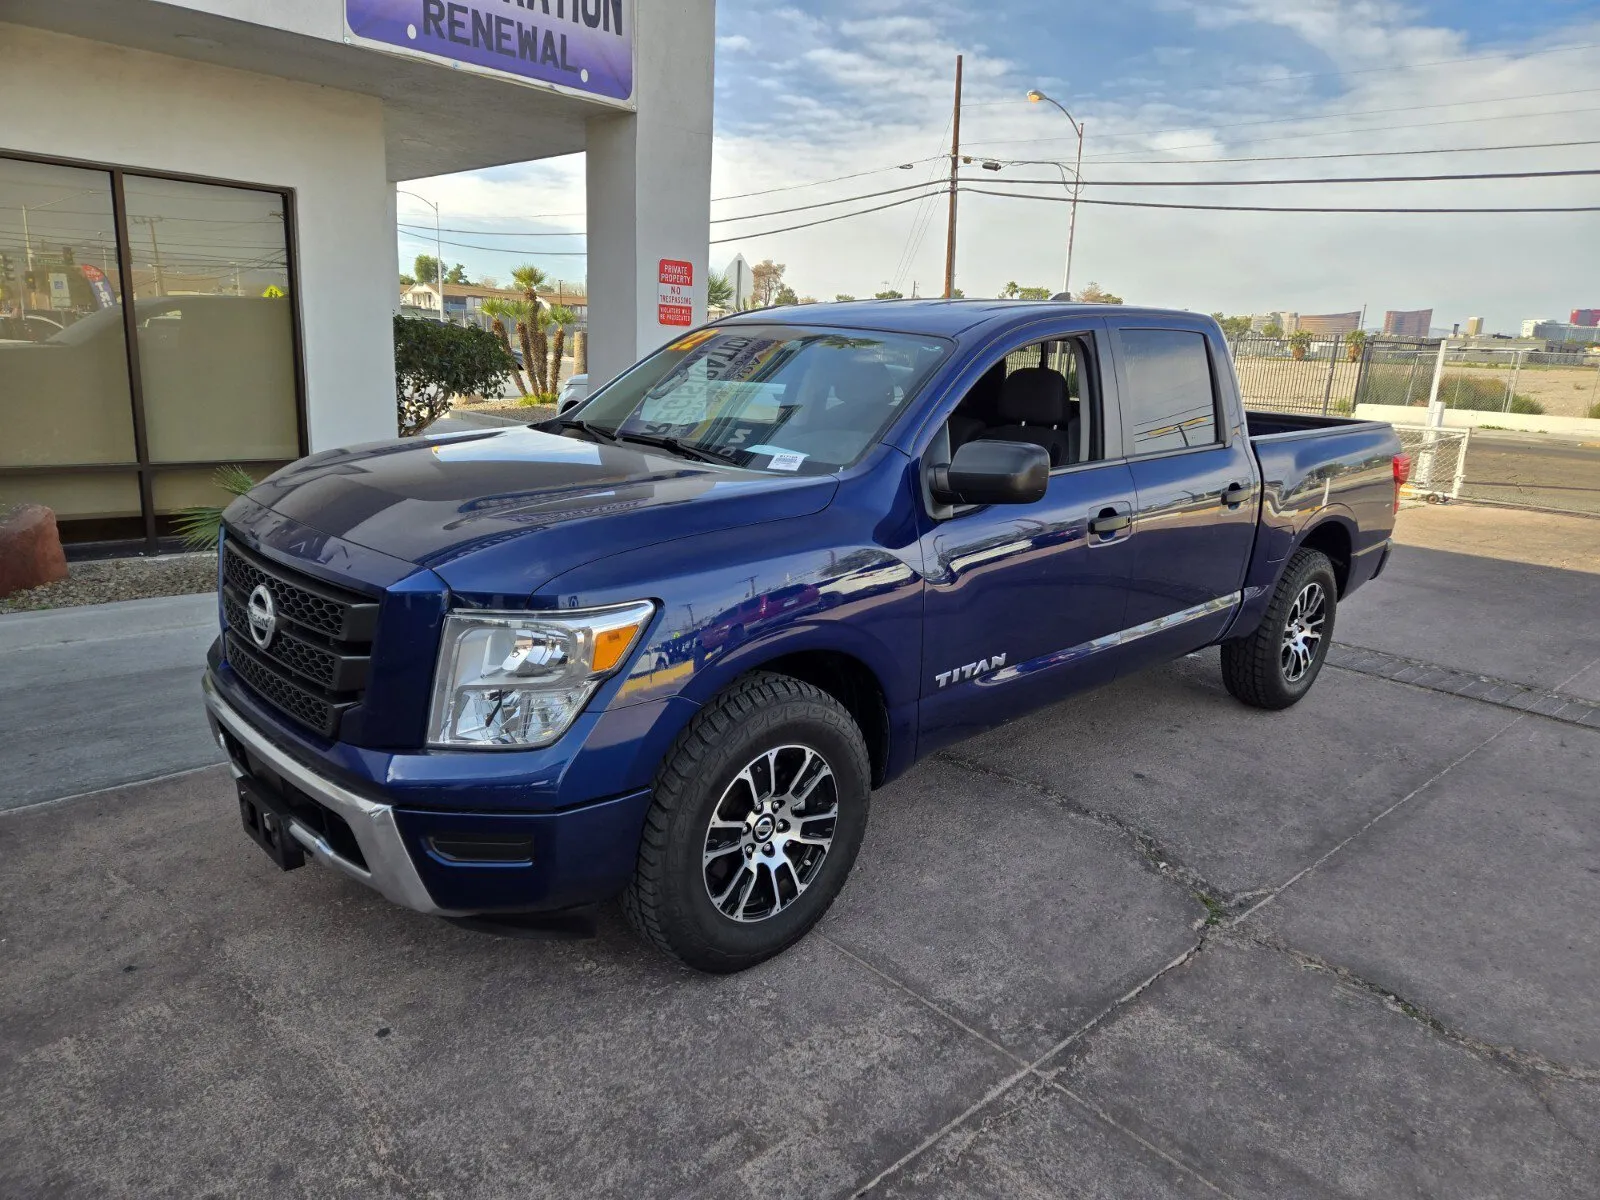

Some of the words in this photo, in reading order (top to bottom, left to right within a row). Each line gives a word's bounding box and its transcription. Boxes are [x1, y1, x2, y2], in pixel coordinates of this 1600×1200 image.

[424, 0, 578, 72] RENEWAL
[664, 265, 687, 275] PRIVATE
[660, 274, 690, 284] PROPERTY
[670, 286, 681, 295] NO
[660, 295, 691, 305] TRESPASSING
[935, 652, 1007, 688] TITAN
